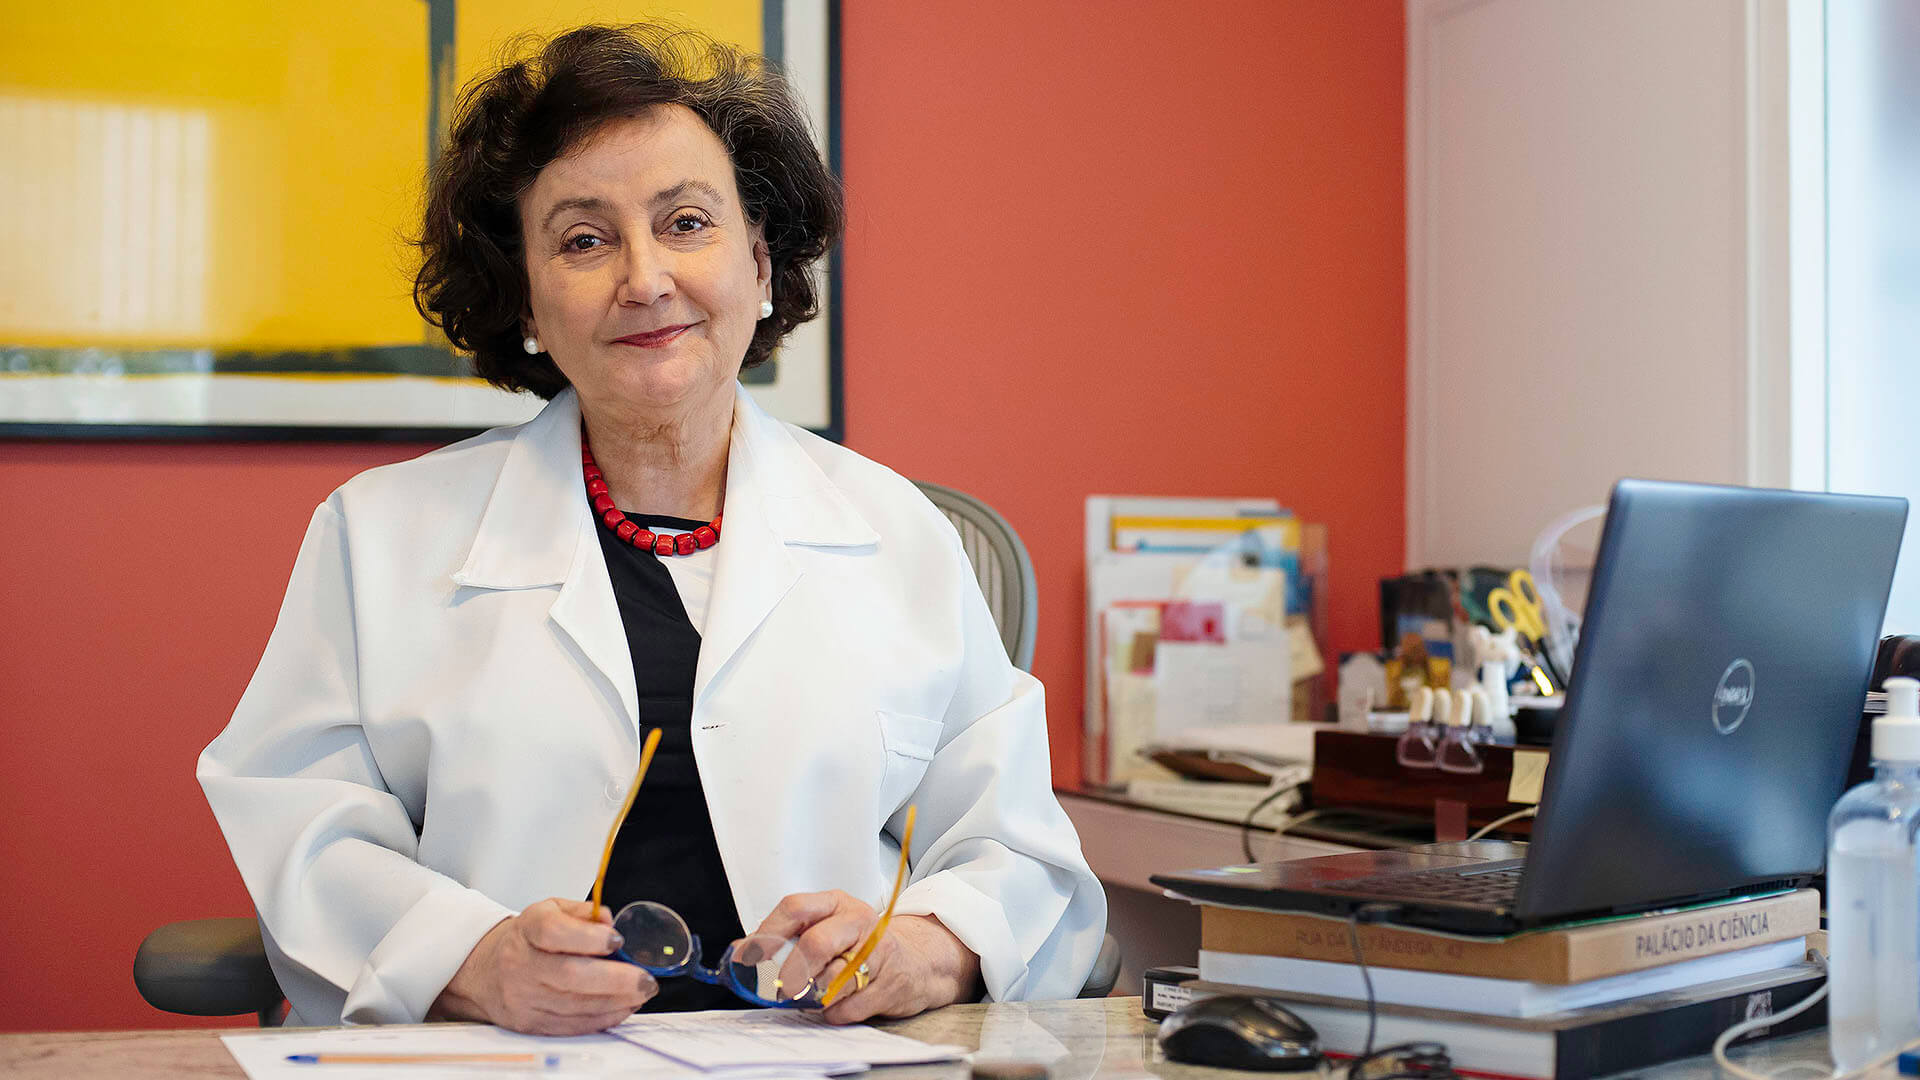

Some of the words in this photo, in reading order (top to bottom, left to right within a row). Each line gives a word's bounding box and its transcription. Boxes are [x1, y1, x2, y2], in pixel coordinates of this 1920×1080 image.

[1635, 924, 1694, 958] PALÁCIO
[1698, 920, 1716, 946] DA
[1719, 912, 1770, 942] CIÊNCIA
